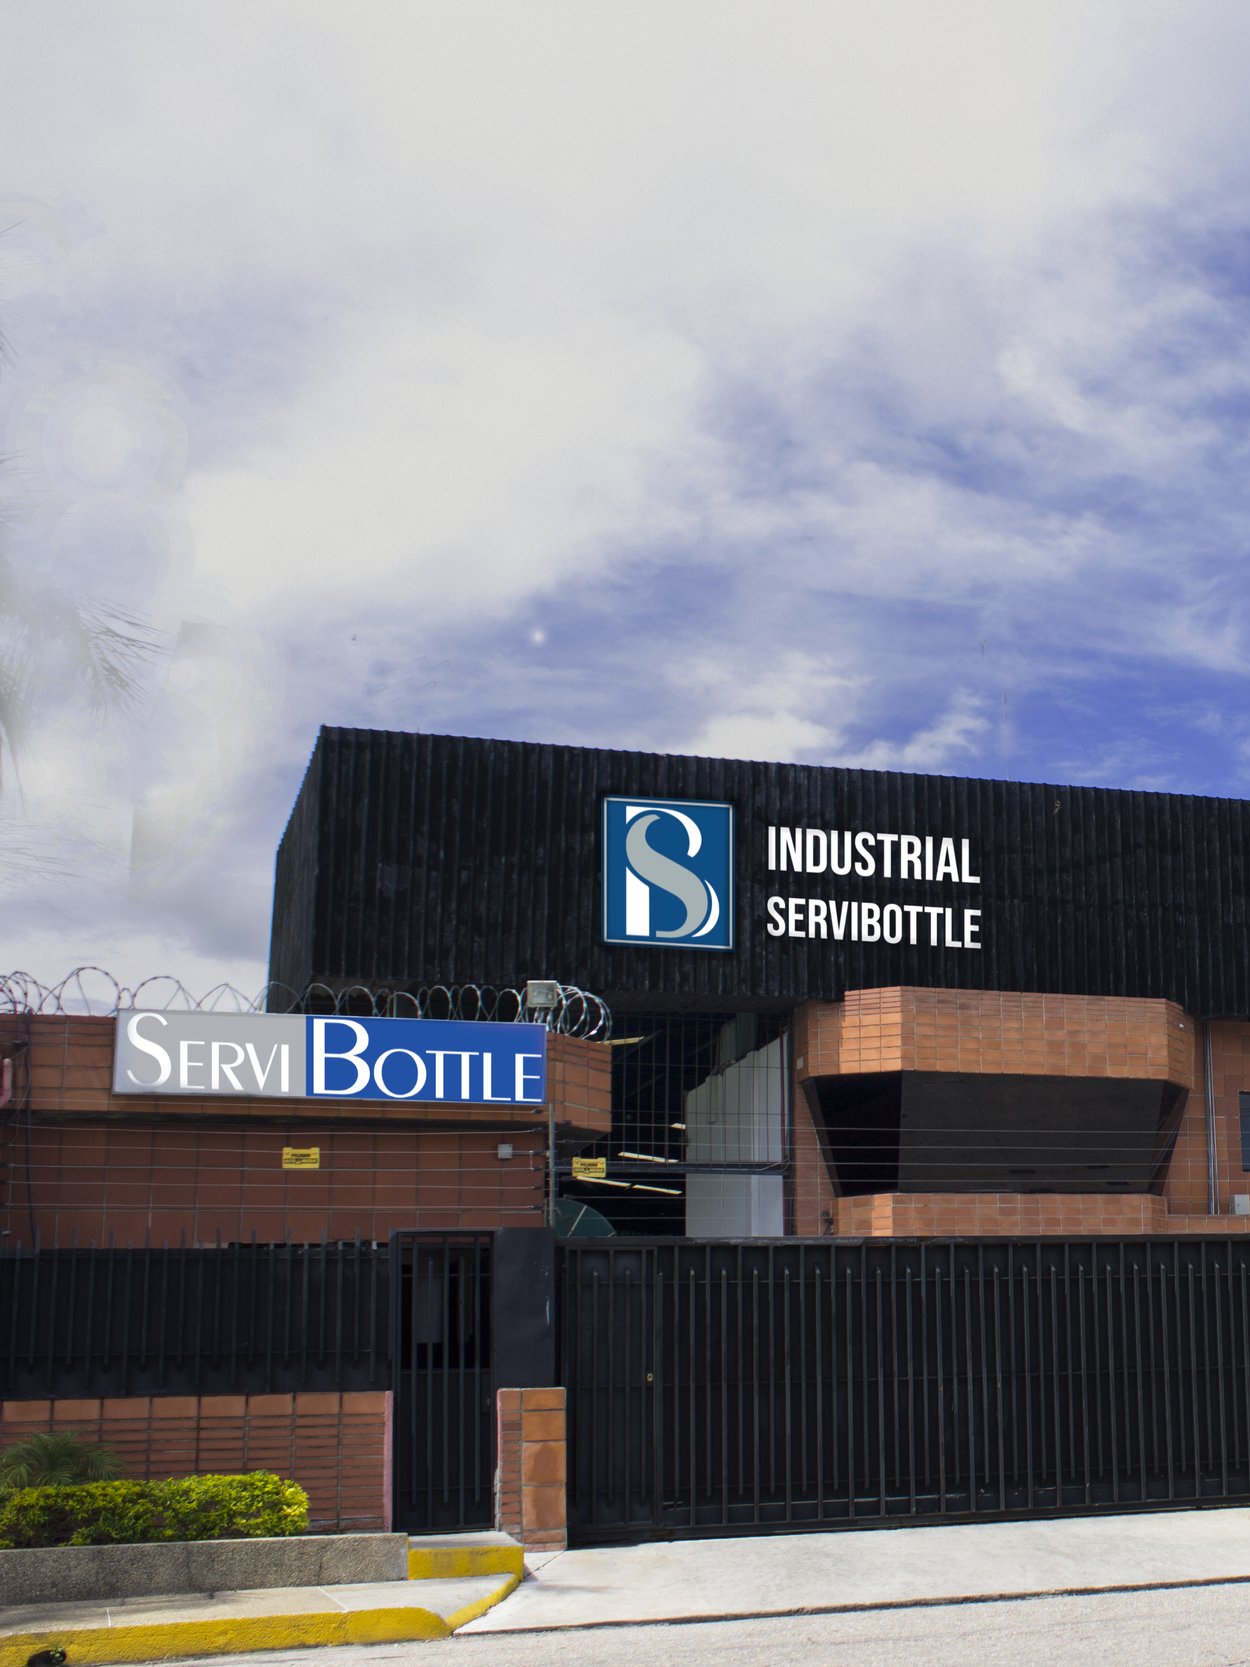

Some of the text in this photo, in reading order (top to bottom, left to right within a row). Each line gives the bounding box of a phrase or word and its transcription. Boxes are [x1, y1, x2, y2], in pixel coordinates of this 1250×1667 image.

[768, 825, 981, 884] INDUSTRIAL
[766, 895, 982, 949] SERVIBOTTLE
[126, 1012, 543, 1103] SERVI BOTTLE
